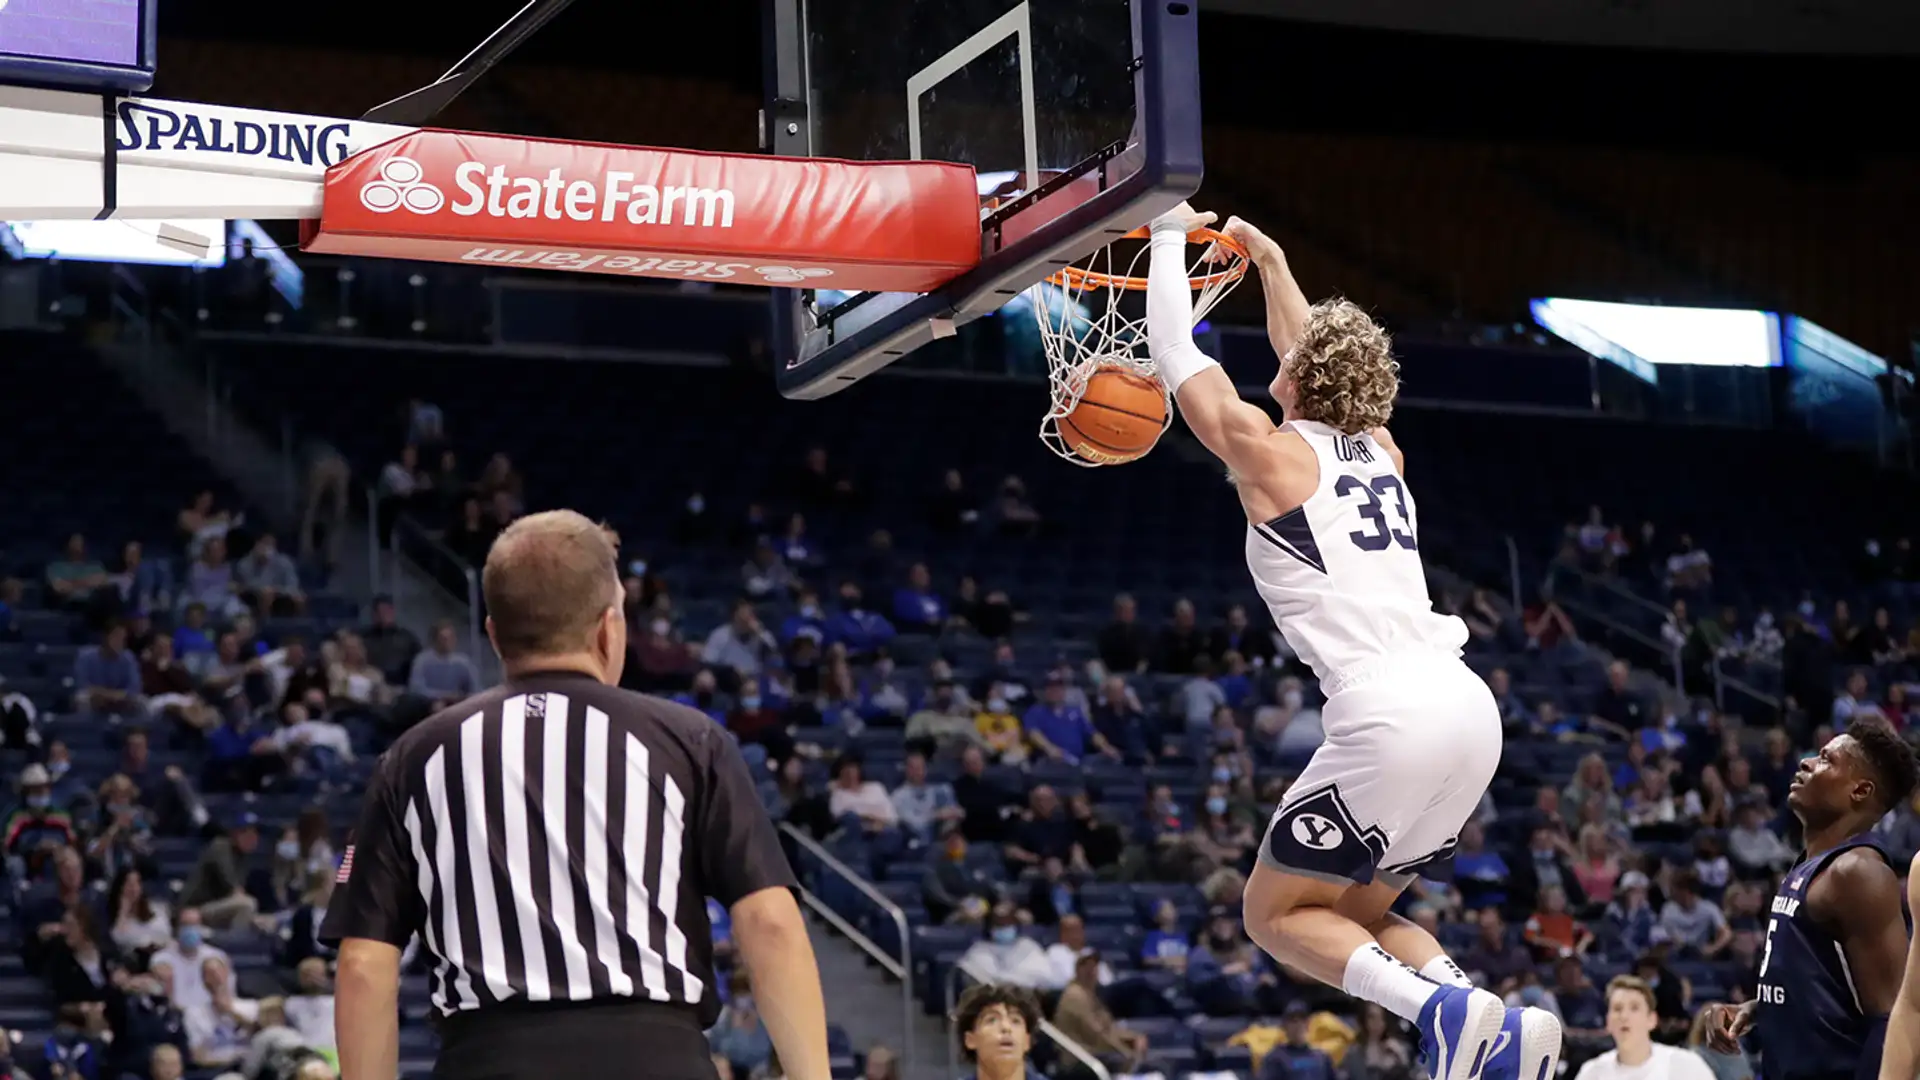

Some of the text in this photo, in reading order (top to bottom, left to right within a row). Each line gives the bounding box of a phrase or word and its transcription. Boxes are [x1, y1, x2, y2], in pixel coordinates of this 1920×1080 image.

[117, 101, 350, 167] SPALDING
[1334, 474, 1417, 552] 33
[1299, 816, 1337, 847] Y
